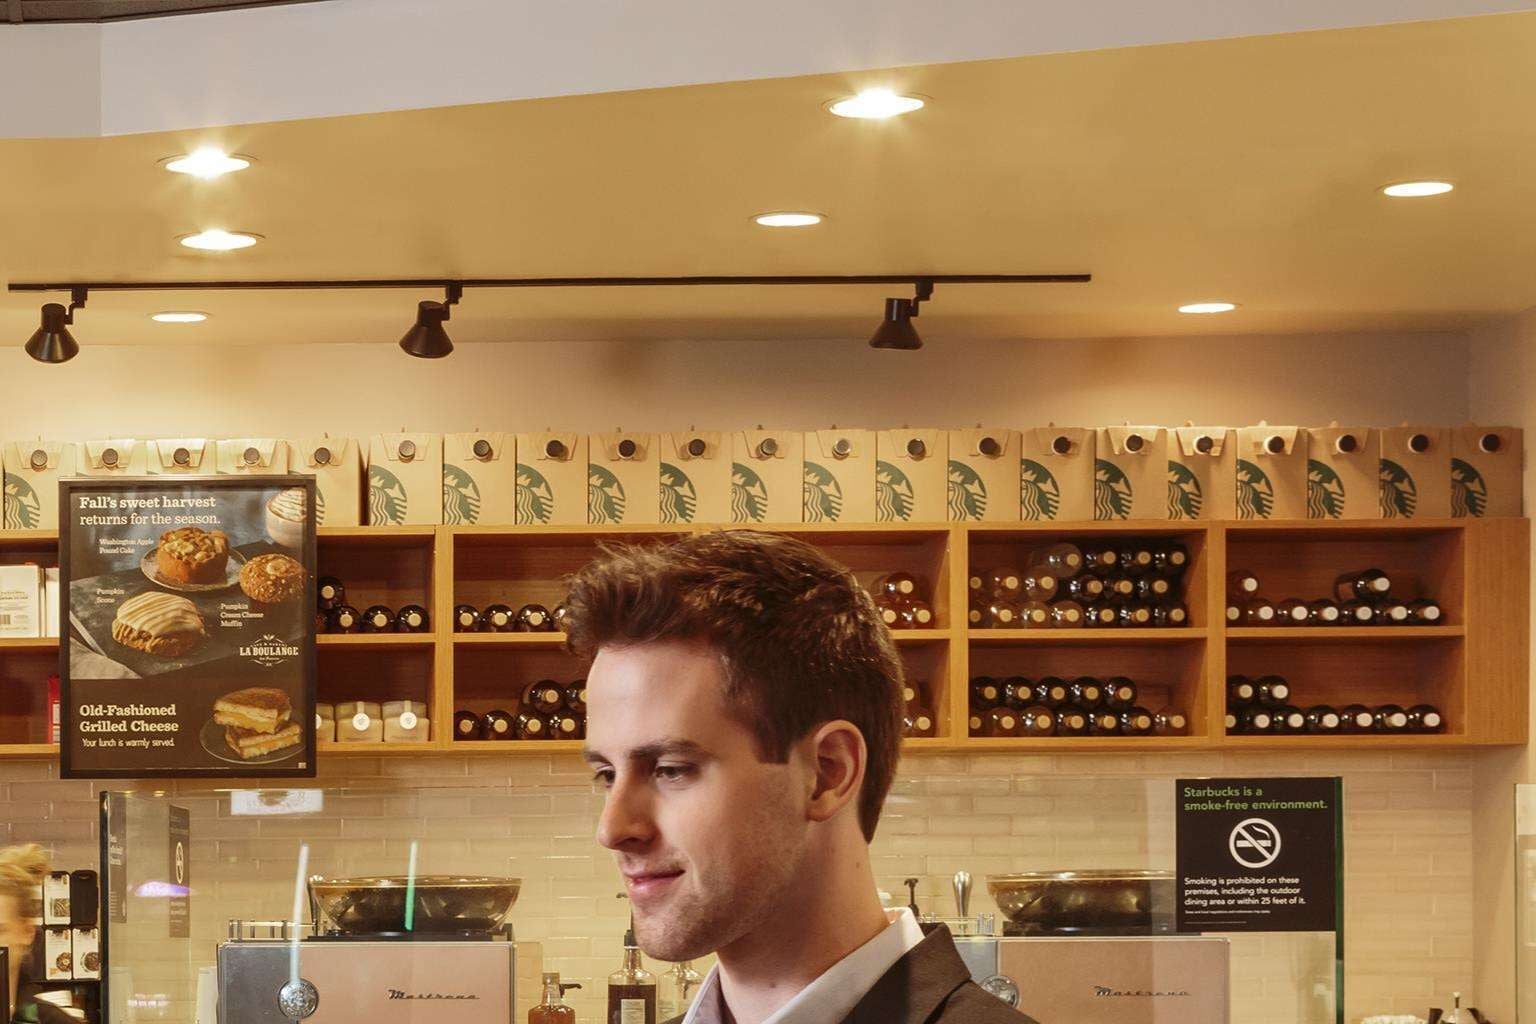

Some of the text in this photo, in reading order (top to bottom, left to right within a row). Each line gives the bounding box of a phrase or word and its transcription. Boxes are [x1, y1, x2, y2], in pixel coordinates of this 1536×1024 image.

[80, 496, 216, 508] Fall's sweet harvest
[80, 513, 220, 525] returns for the season.
[240, 646, 298, 656] LA BOULANGE
[80, 704, 176, 717] Old-Fashioned
[80, 720, 178, 732] Grilled Cheese
[82, 738, 96, 748] Your
[98, 738, 116, 747] lunch
[125, 738, 150, 748] warmly
[152, 738, 175, 747] served.
[1184, 788, 1239, 797] Starbucks
[1243, 787, 1252, 796] is
[1184, 800, 1328, 811] smoke-free environment.
[1184, 877, 1217, 886] Smoking
[1226, 877, 1265, 886] prohibited
[1221, 887, 1255, 896] including
[1184, 898, 1208, 906] dining
